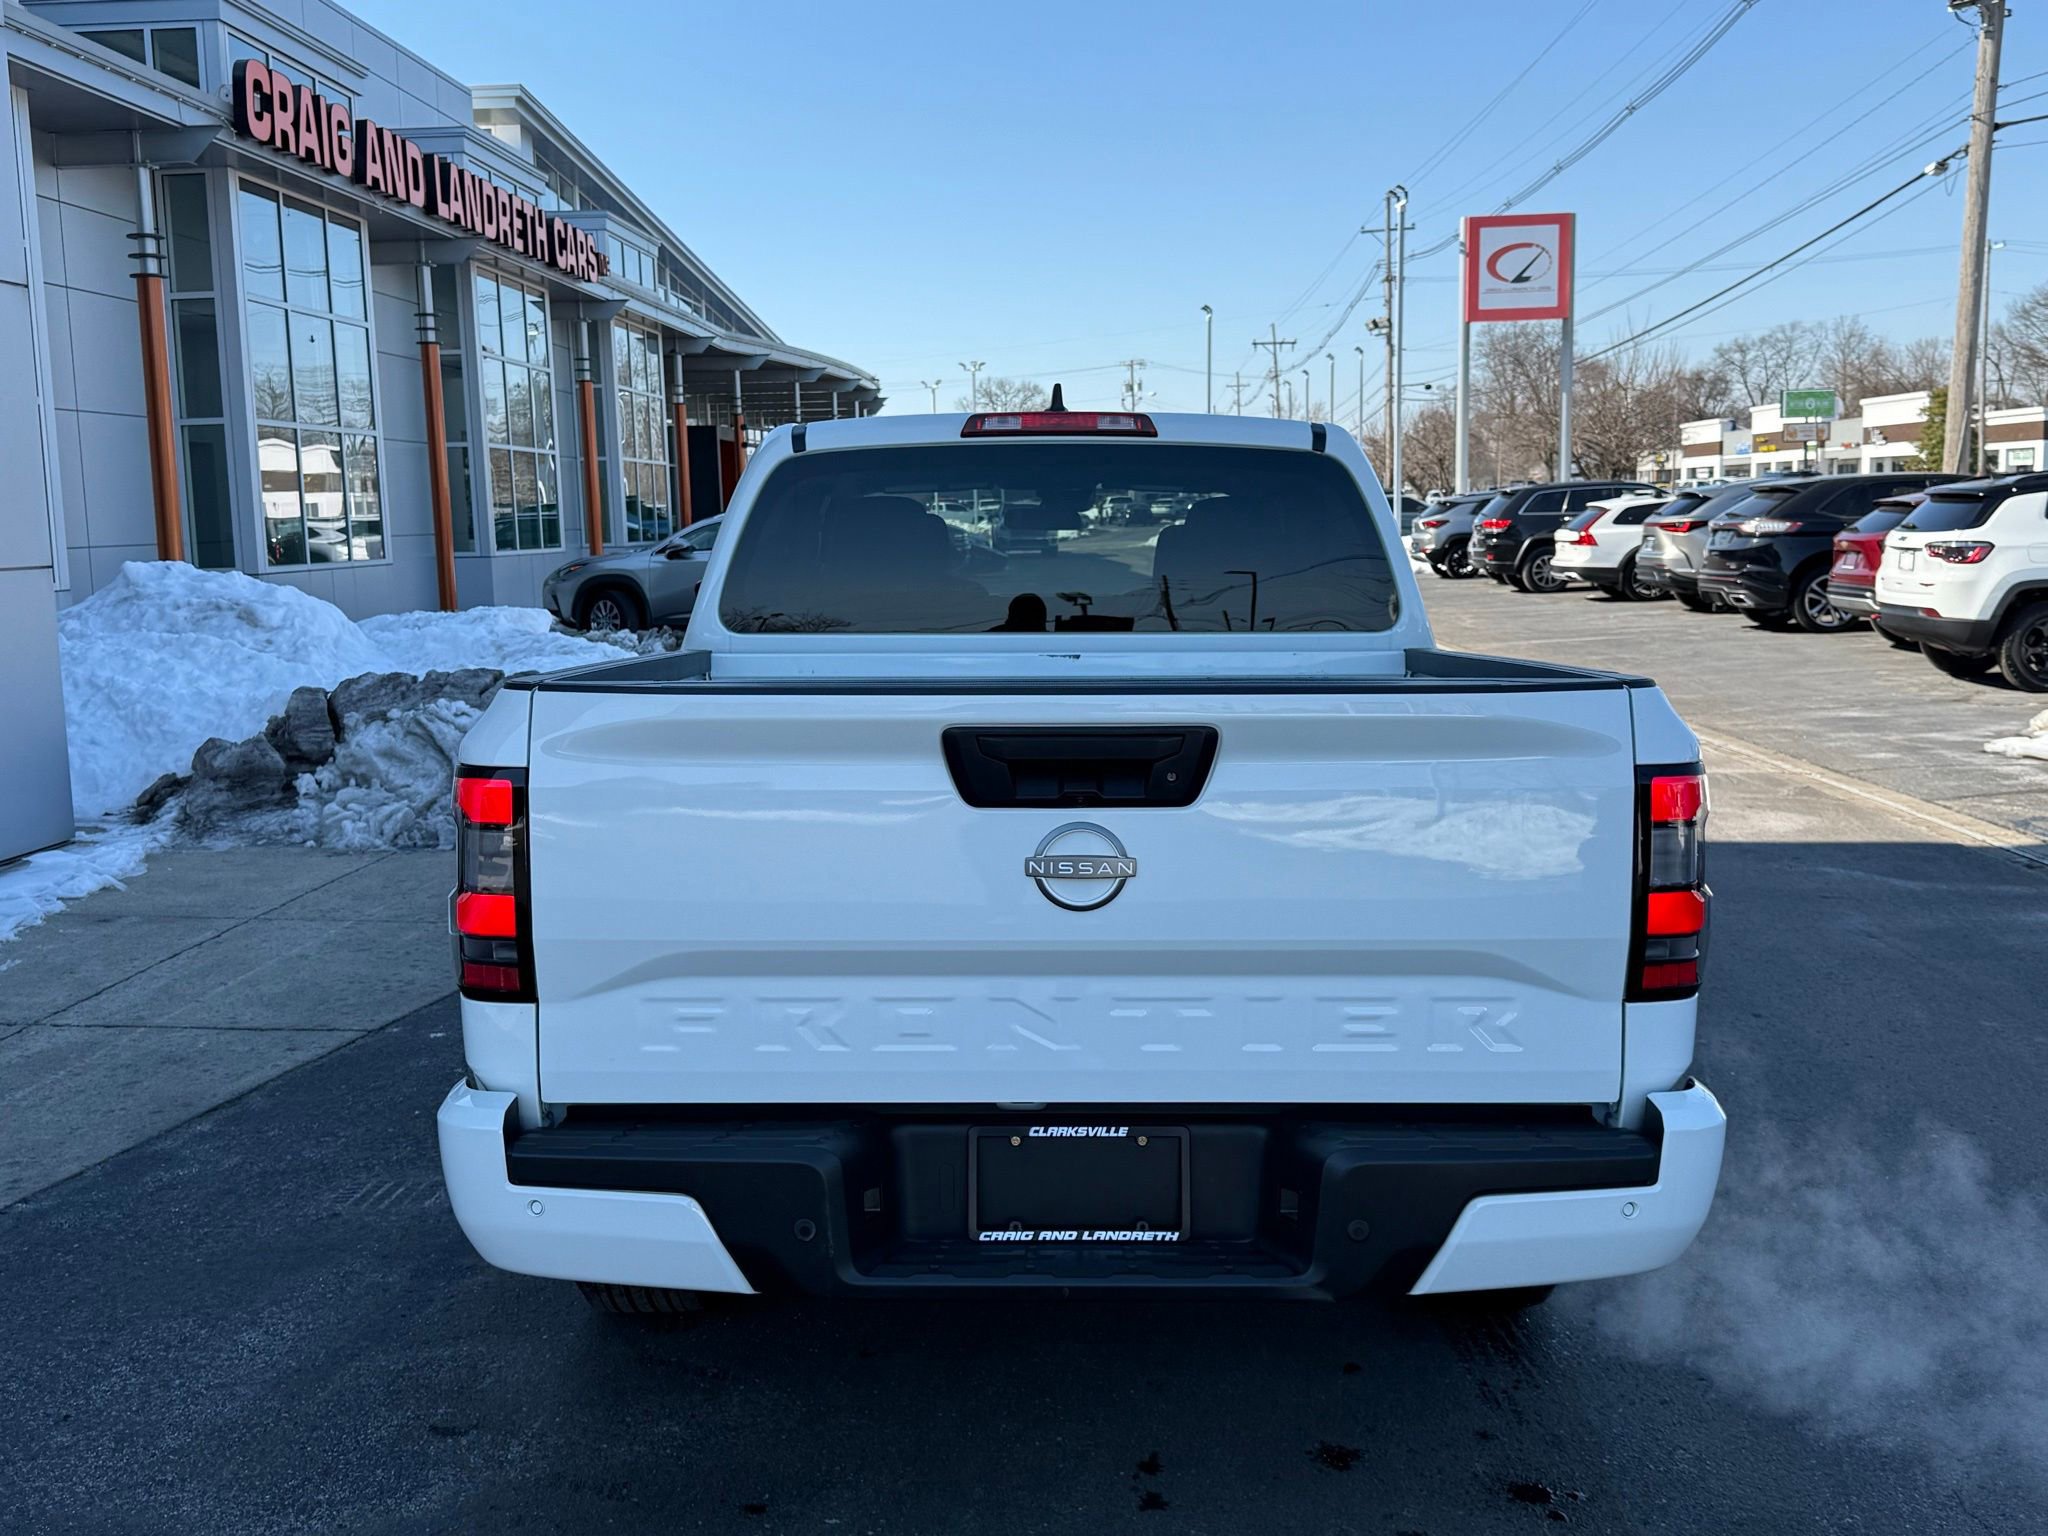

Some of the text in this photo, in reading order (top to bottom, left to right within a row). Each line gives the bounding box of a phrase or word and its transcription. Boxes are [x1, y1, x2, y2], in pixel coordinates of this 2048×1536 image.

[244, 58, 354, 177] CRAIG
[365, 119, 427, 209] AND
[433, 153, 549, 264] LANDRETH
[553, 216, 599, 283] CARS
[1028, 861, 1133, 875] NISSAN
[639, 997, 1526, 1053] FRONTIER
[1028, 1126, 1129, 1138] CLARKSVILLE
[978, 1231, 1180, 1242] CRAIG AND LANDRETH
